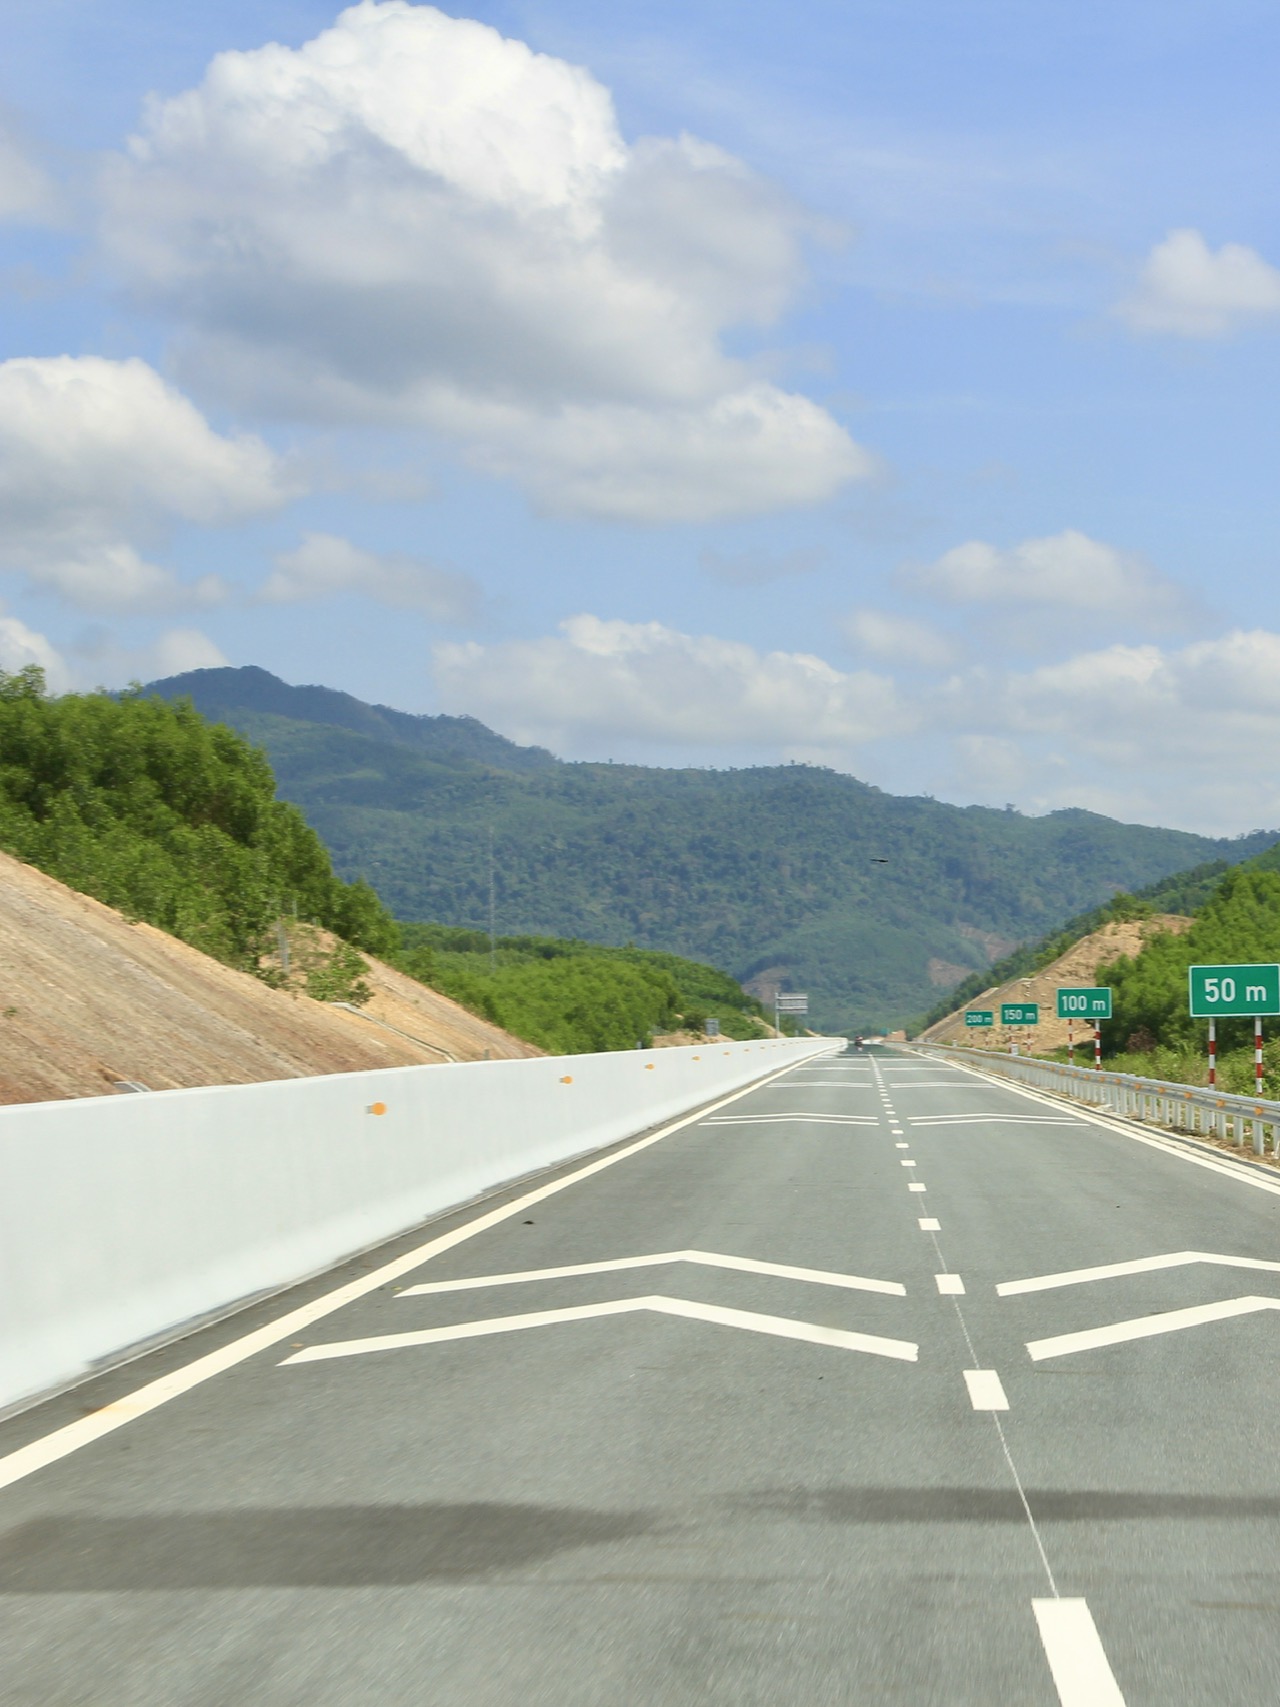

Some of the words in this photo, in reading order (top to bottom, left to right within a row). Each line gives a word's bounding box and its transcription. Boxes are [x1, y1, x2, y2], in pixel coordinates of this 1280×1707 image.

[1204, 978, 1236, 1002] 50
[1246, 985, 1267, 1002] m
[1062, 995, 1087, 1011] 100
[1092, 1000, 1106, 1012] m
[967, 1015, 983, 1023] 200
[1004, 1009, 1023, 1020] 150
